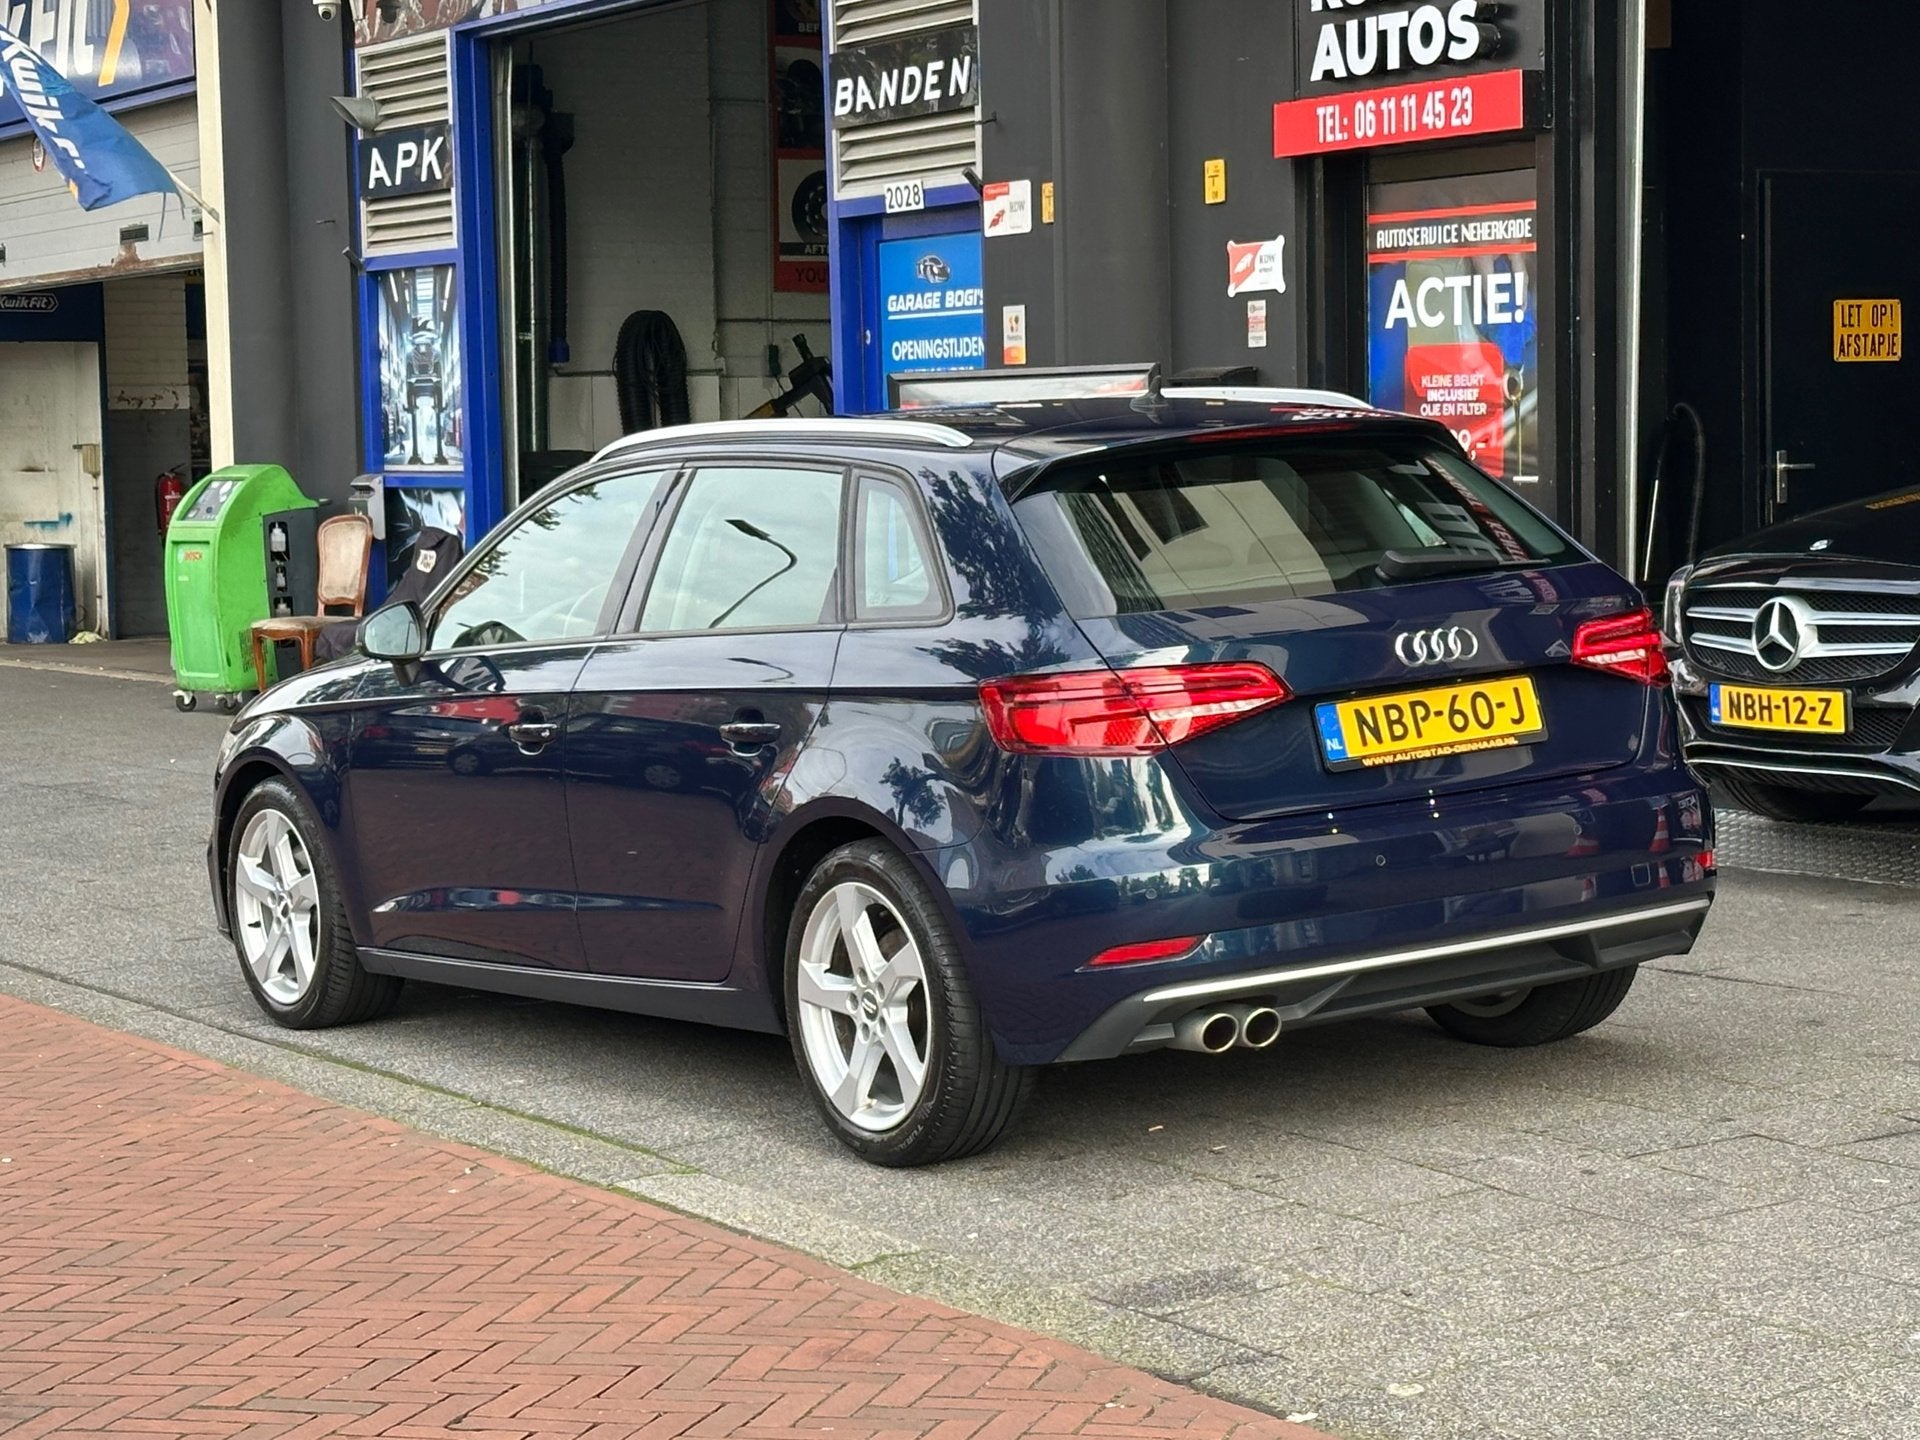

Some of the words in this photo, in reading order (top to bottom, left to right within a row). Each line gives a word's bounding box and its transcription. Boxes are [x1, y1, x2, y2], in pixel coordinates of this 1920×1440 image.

[798, 22, 820, 33] BEF
[1310, 0, 1480, 82] AUTOS
[834, 55, 971, 117] BANDEN
[1316, 104, 1349, 144] TEL:
[1354, 99, 1376, 139] 06
[1380, 96, 1396, 136] 11
[1401, 93, 1417, 133] 11
[1422, 90, 1446, 130] 45
[1450, 86, 1473, 127] 23
[368, 136, 444, 189] APK
[885, 184, 921, 211] 2028
[1461, 218, 1532, 242] NEHERKADE
[804, 244, 826, 255] AFT
[887, 290, 941, 312] GARAGE
[1384, 271, 1525, 329] ACTIE!
[1841, 304, 1862, 328] LET
[1870, 303, 1894, 328] OP!
[892, 335, 985, 361] OPENINGSTIJDEN
[1838, 333, 1898, 358] AFSTAPJE
[1421, 375, 1452, 388] KLEINE
[1454, 373, 1484, 387] BEURT
[1427, 388, 1479, 402] INCLUSIEF
[1420, 402, 1441, 416] OLIE
[1443, 402, 1455, 416] EN
[1457, 402, 1487, 416] FILTER
[1326, 738, 1343, 750] NL
[1353, 686, 1526, 748] NBP-60-J
[1728, 691, 1833, 726] NBH-12-Z
